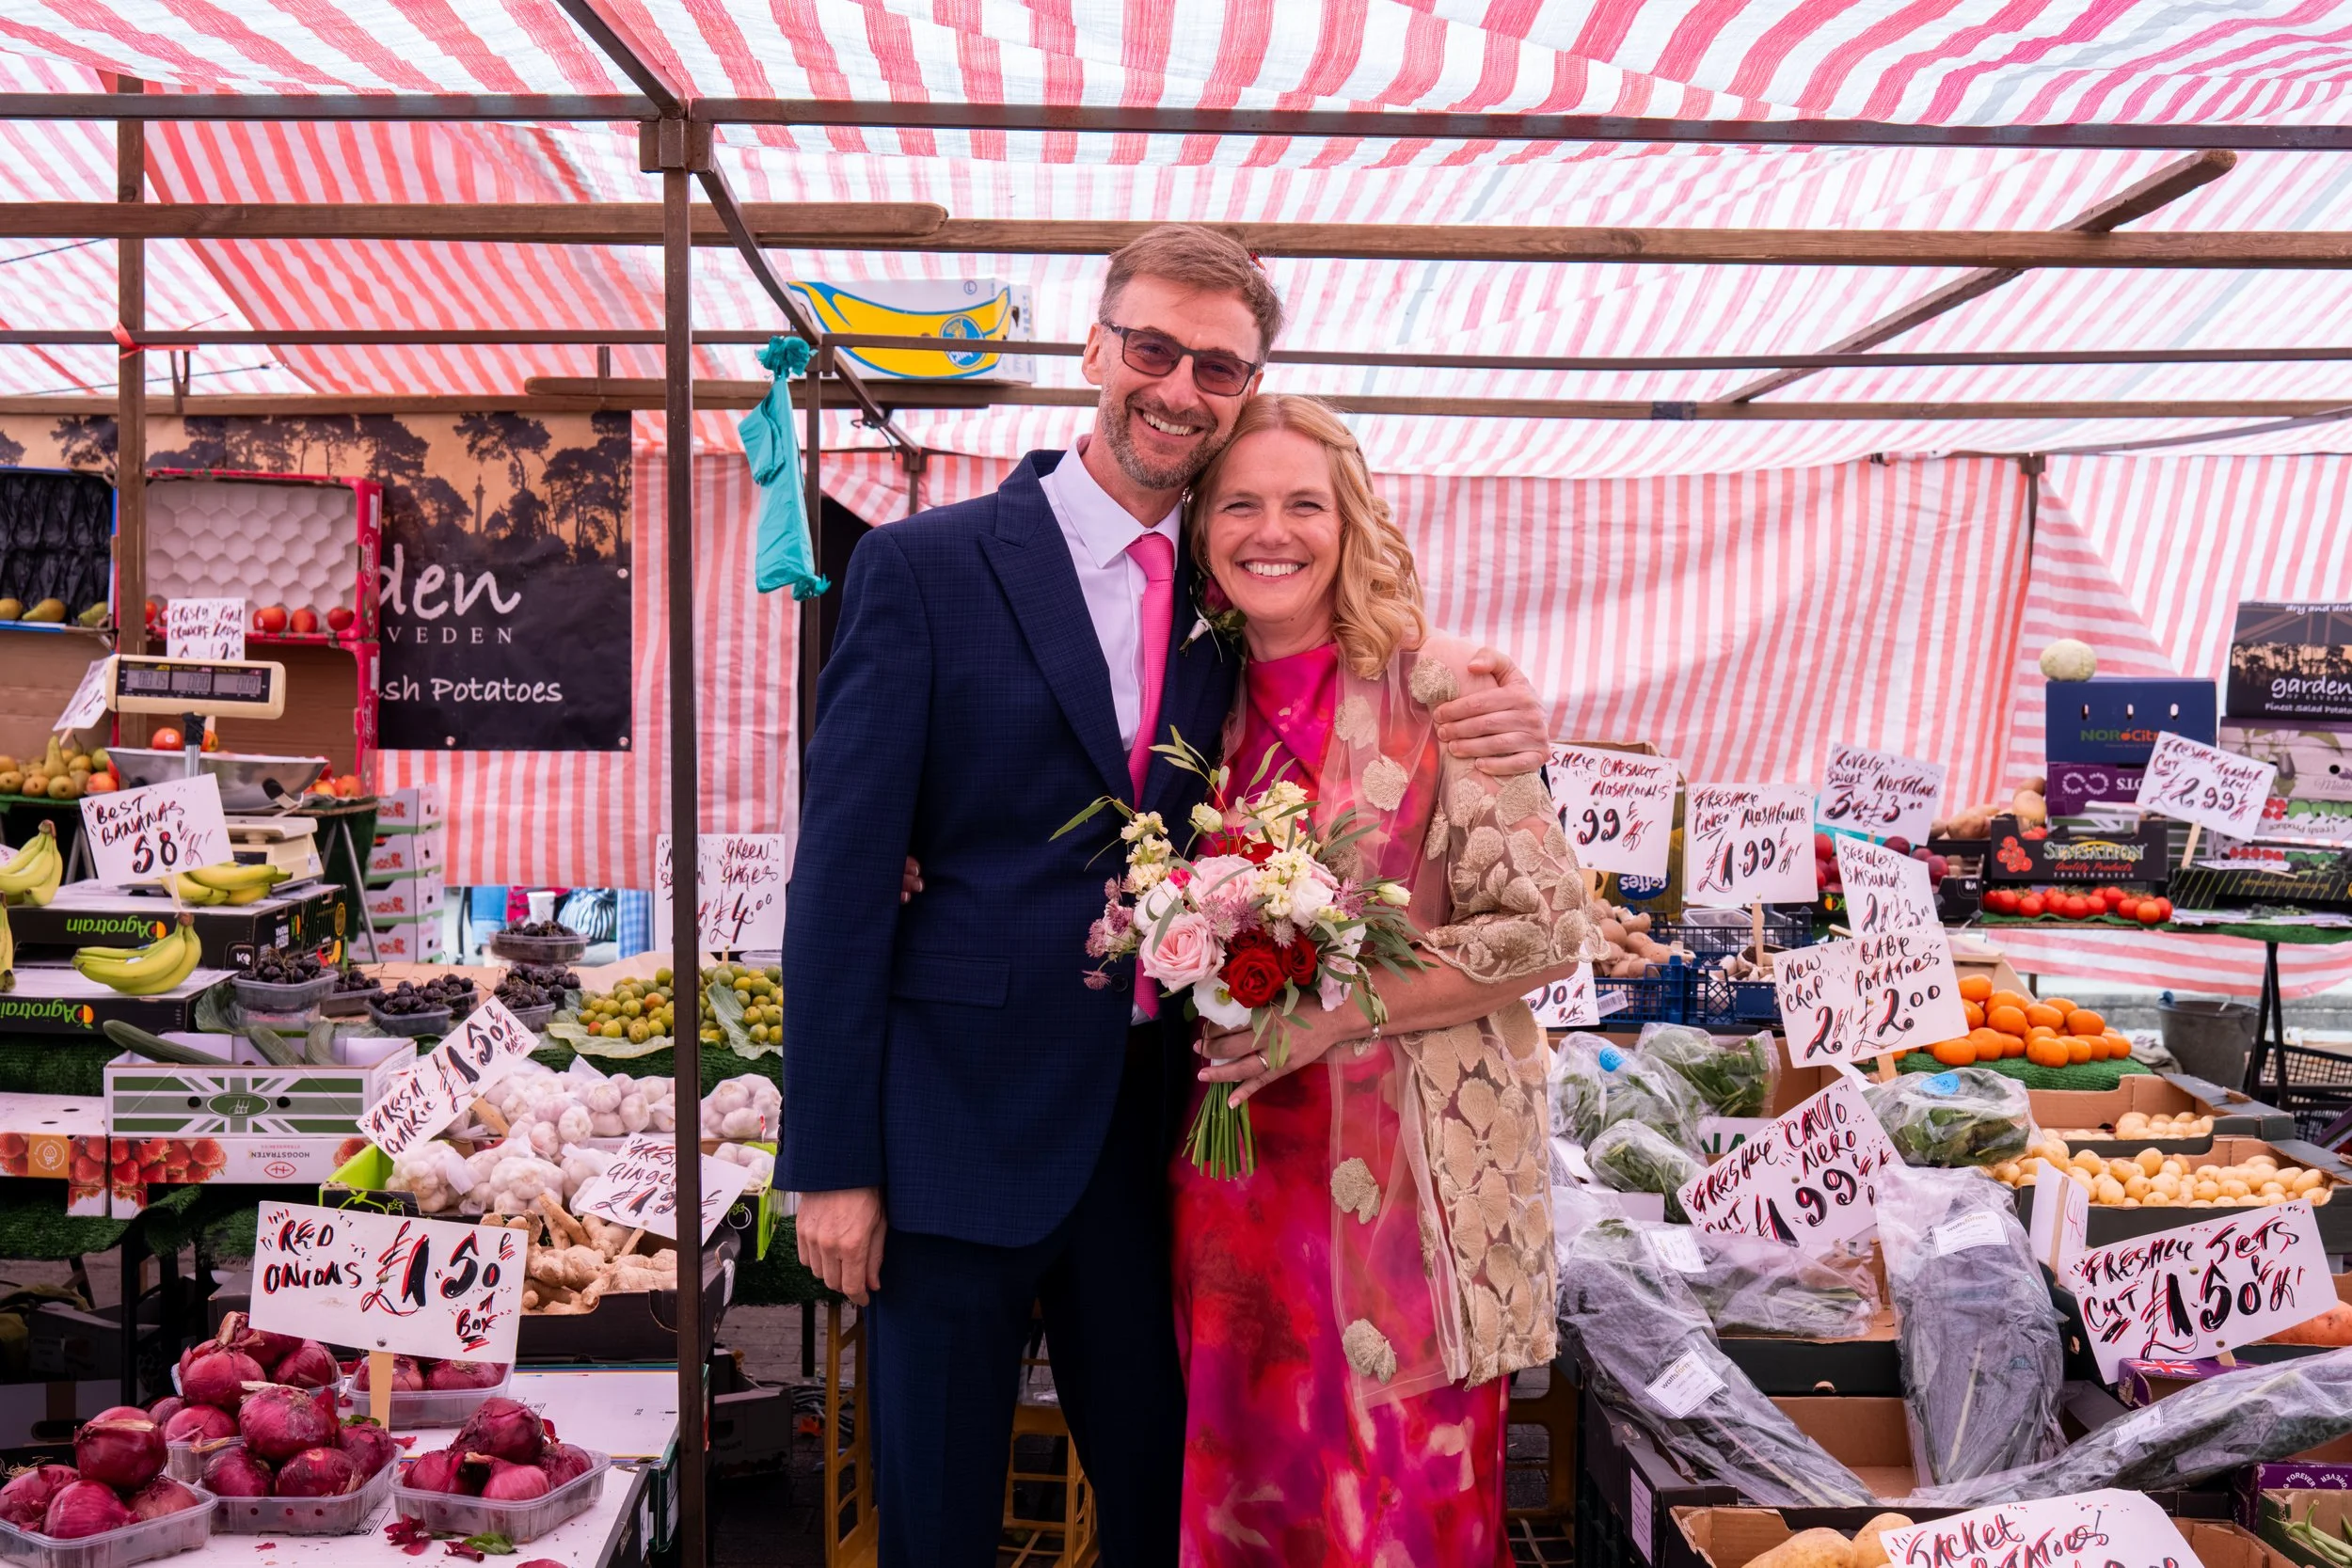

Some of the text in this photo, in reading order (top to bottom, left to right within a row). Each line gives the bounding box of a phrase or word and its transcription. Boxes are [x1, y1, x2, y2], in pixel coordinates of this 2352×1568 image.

[378, 544, 521, 620] den
[387, 626, 514, 644] VEDEN
[378, 674, 564, 703] sh Potatoes
[66, 915, 148, 939] Agrotrain
[0, 999, 73, 1023] Agrotrai
[628, 1141, 676, 1168] FRES
[278, 1217, 334, 1256] RED
[2084, 1282, 2140, 1332] CUT
[2286, 1472, 2316, 1488] FOREVER
